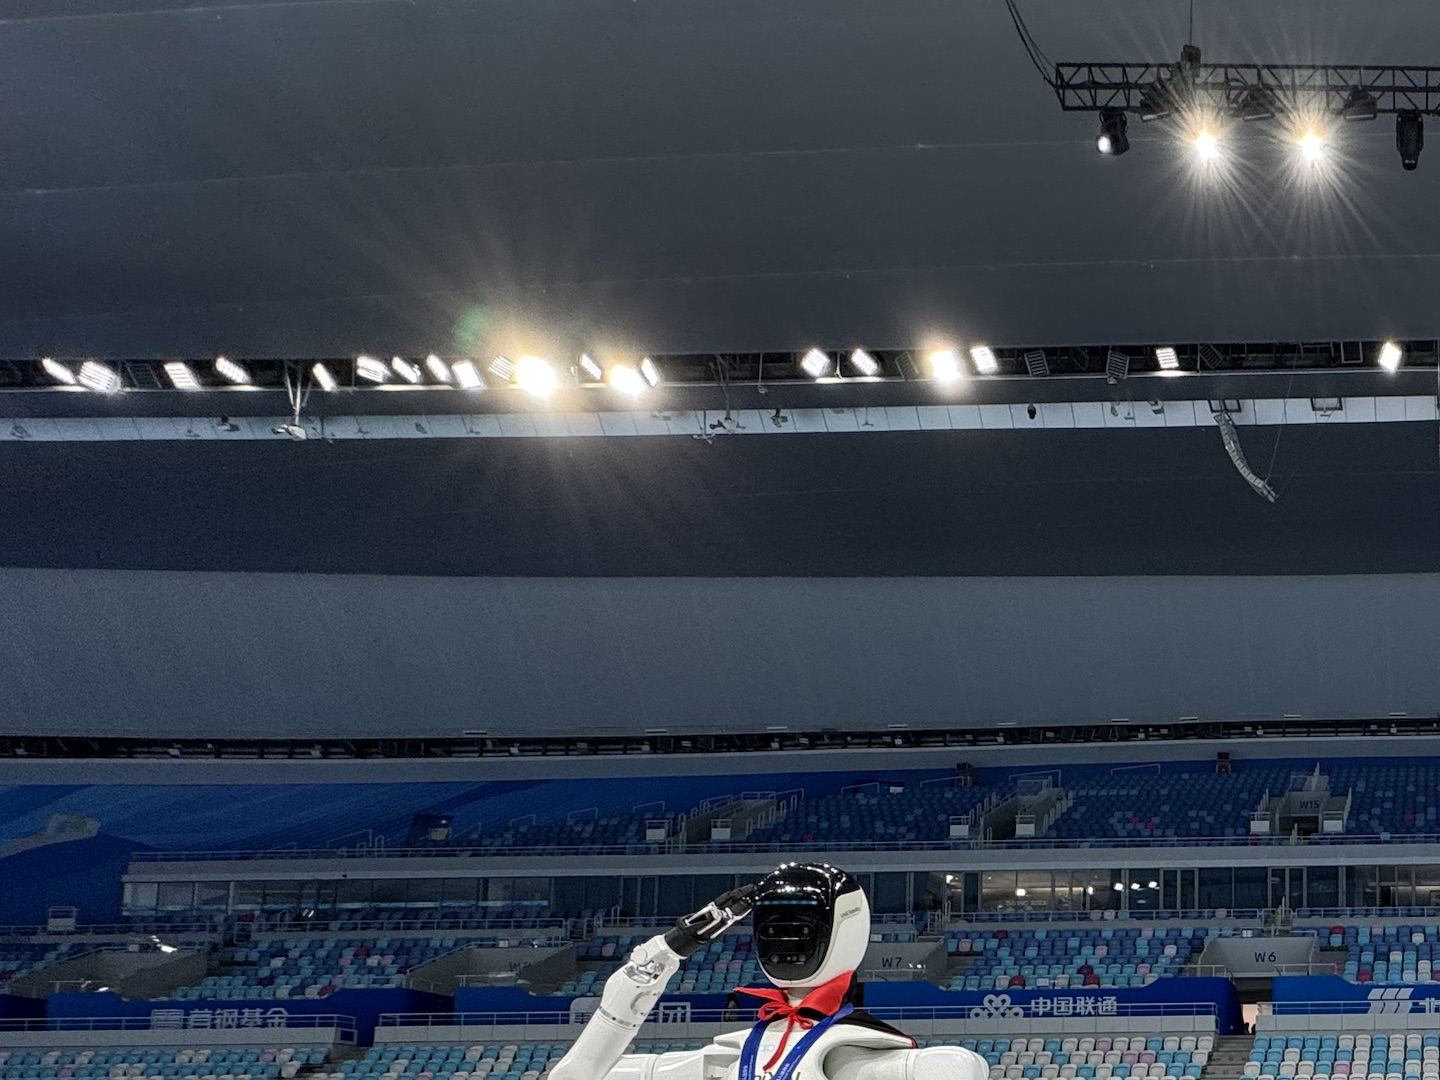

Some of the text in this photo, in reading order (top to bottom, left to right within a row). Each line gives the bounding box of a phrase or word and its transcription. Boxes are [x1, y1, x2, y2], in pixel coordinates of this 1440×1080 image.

[1030, 995, 1118, 1017] 中国联通
[188, 1006, 290, 1029] 首钢基金
